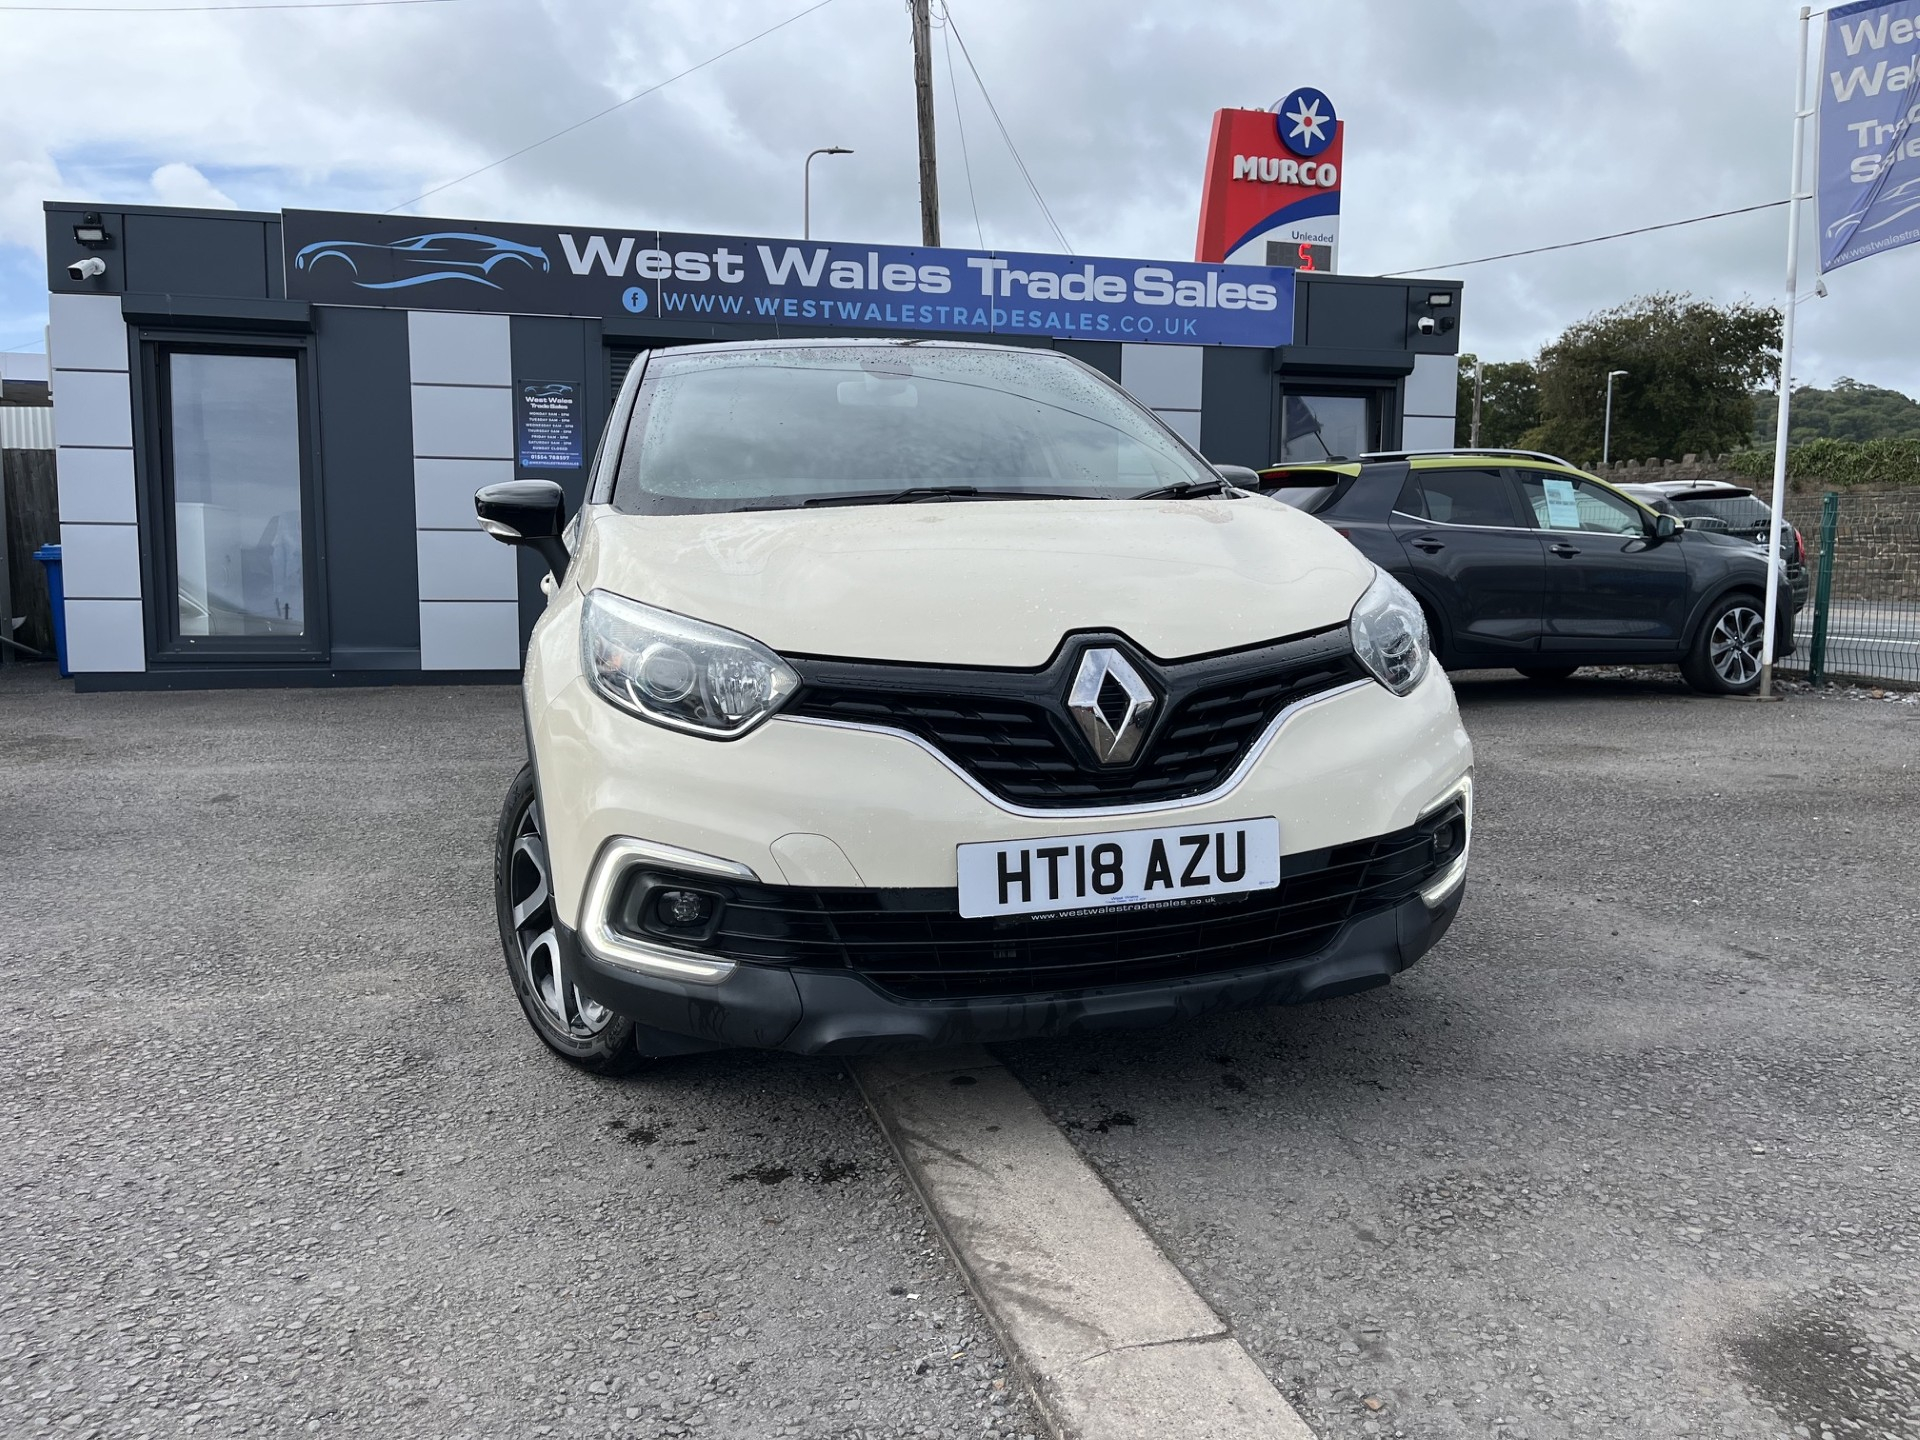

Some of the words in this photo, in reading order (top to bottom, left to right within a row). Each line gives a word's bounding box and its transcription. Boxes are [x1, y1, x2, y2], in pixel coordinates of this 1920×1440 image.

[1830, 54, 1920, 103] Wal
[1233, 154, 1337, 187] MURCO
[1291, 230, 1333, 243] Unleaded
[558, 233, 745, 284] West
[757, 245, 952, 294] Wales
[967, 257, 1127, 303] Trade
[1134, 267, 1278, 312] Sales
[663, 292, 1198, 336] WWW.WESTWALESTRADESALES.CO.UK
[996, 842, 1124, 905] HT18
[1143, 830, 1246, 891] AZU
[1031, 896, 1216, 921] www.westwalestradesales.co.uk
